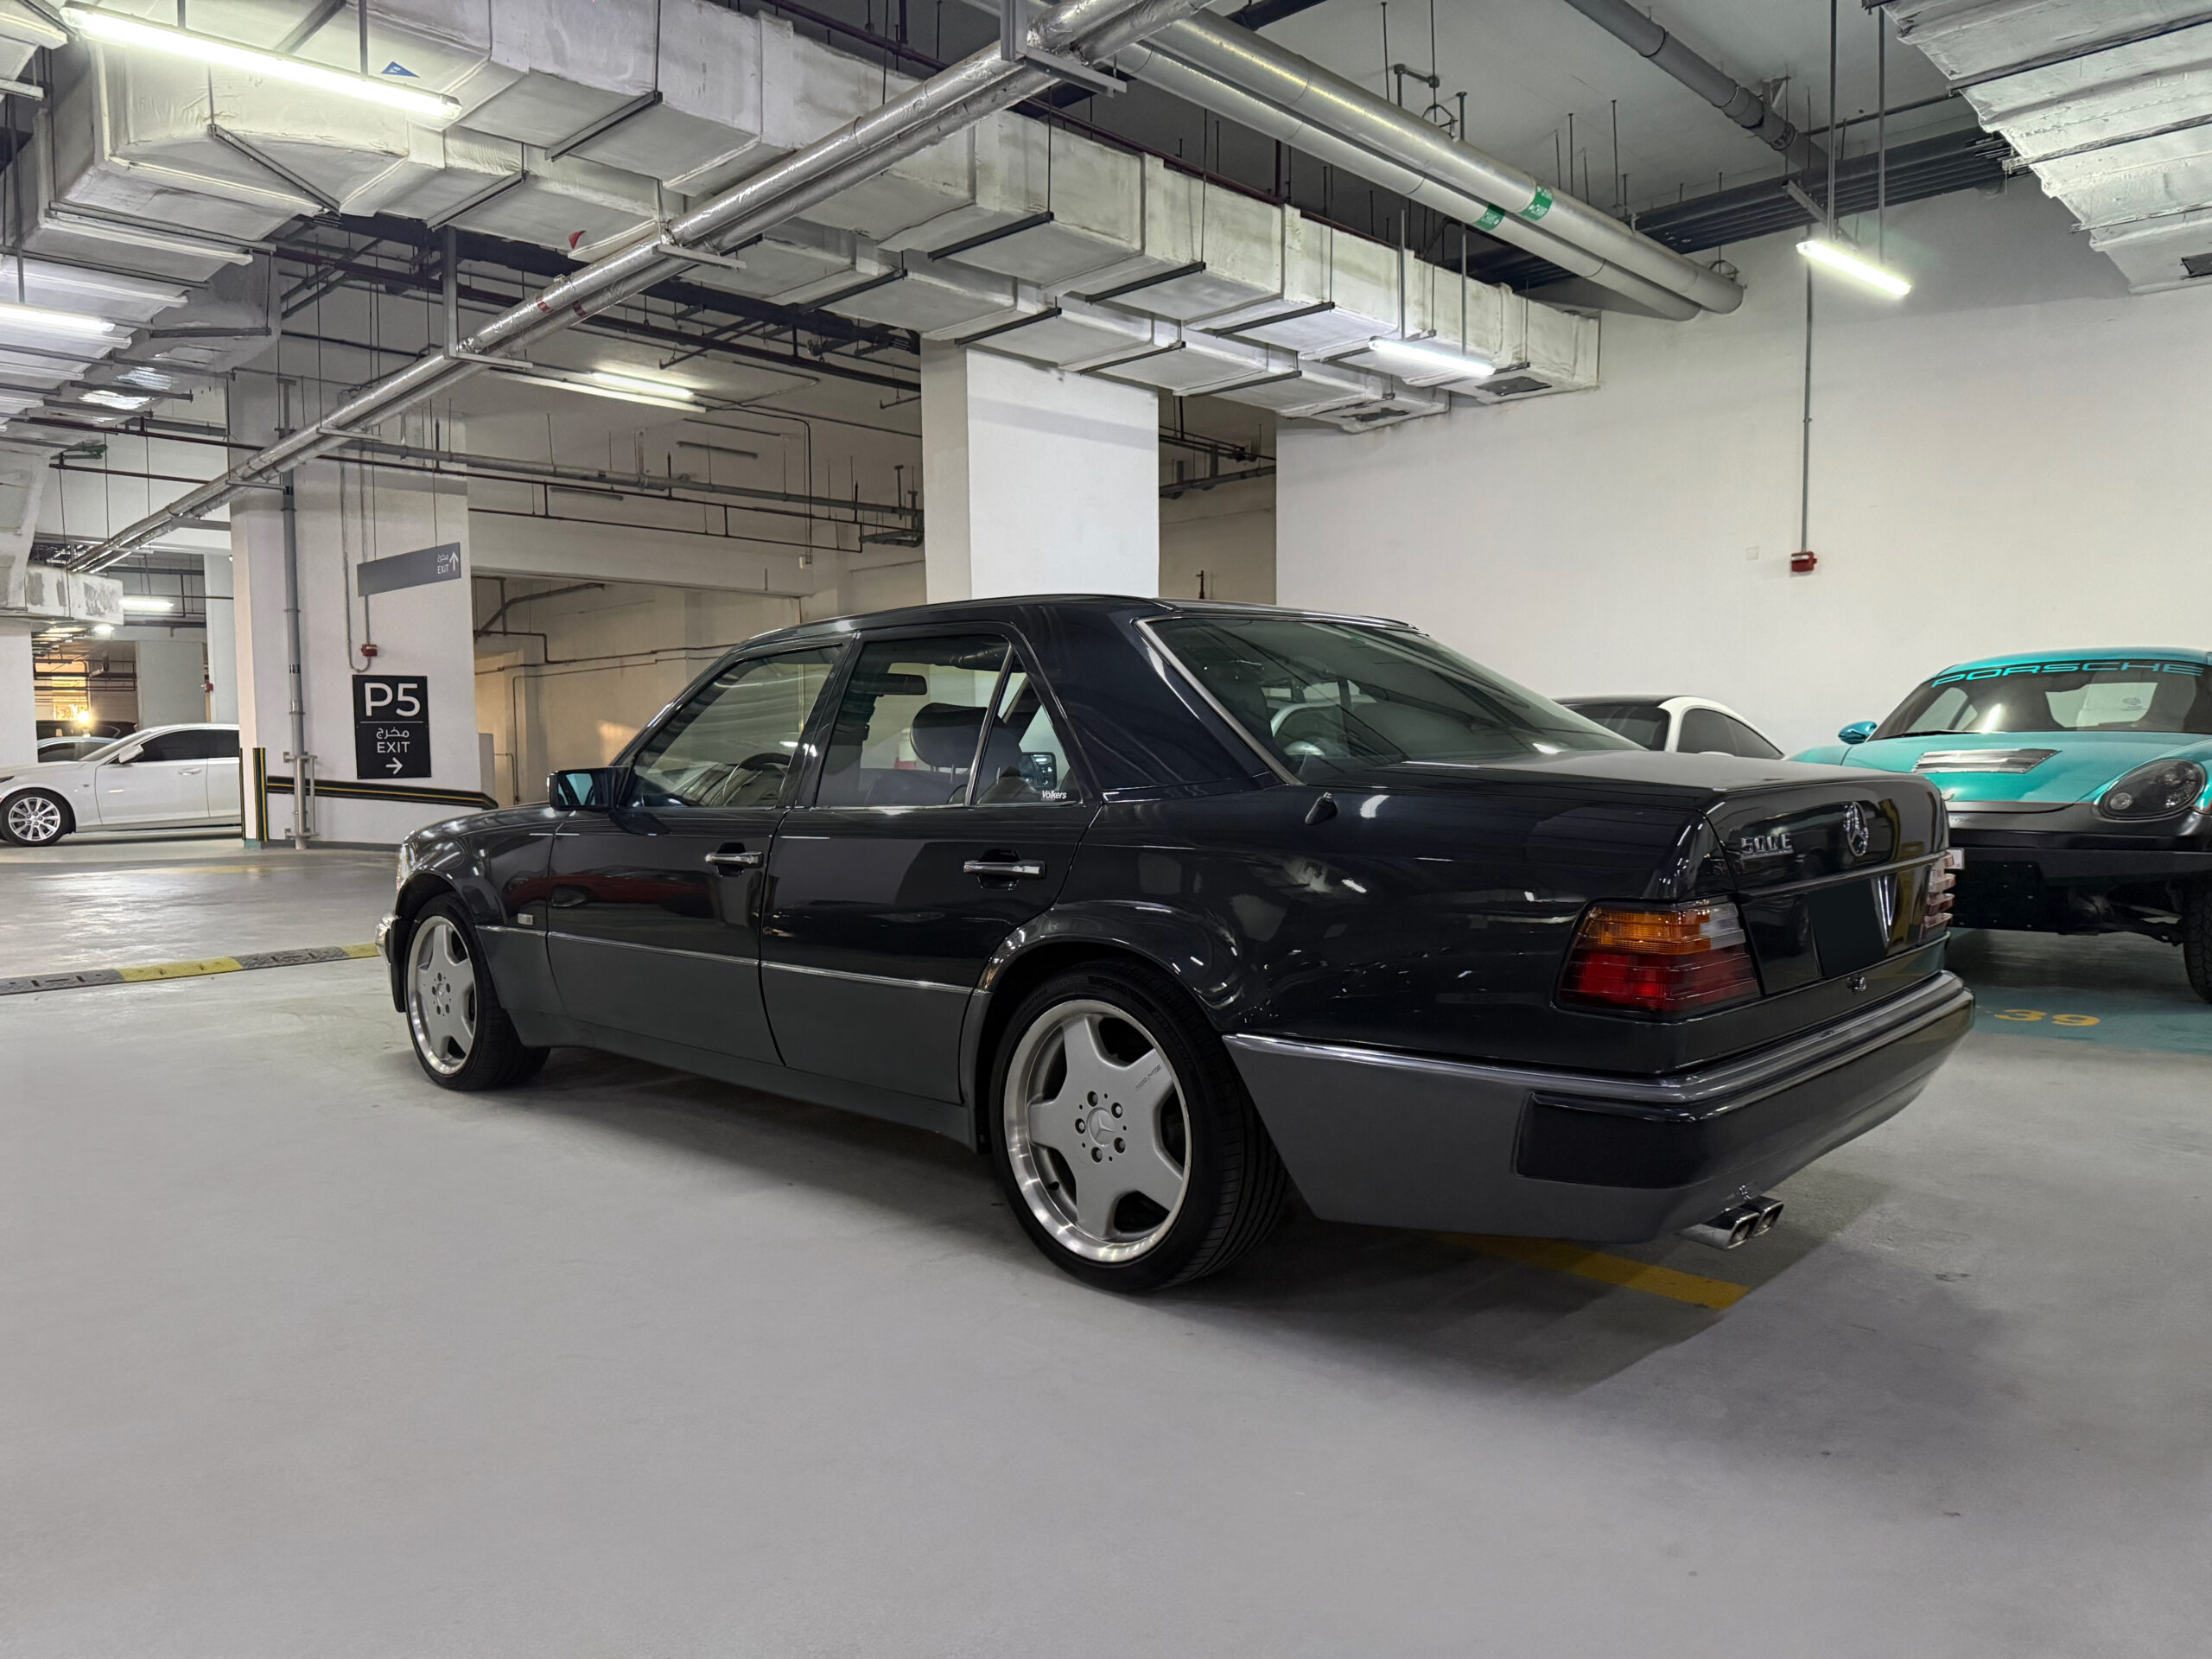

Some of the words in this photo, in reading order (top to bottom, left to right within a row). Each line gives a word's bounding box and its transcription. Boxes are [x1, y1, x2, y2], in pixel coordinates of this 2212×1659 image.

[437, 564, 449, 574] EXIT
[1931, 662, 2204, 688] PORSCHE
[365, 683, 421, 717] P5
[376, 727, 410, 740] مخرج
[377, 741, 410, 753] EXIT
[1042, 790, 1067, 799] Völkers
[1740, 833, 1792, 855] 500E
[1994, 1009, 2101, 1027] 39
